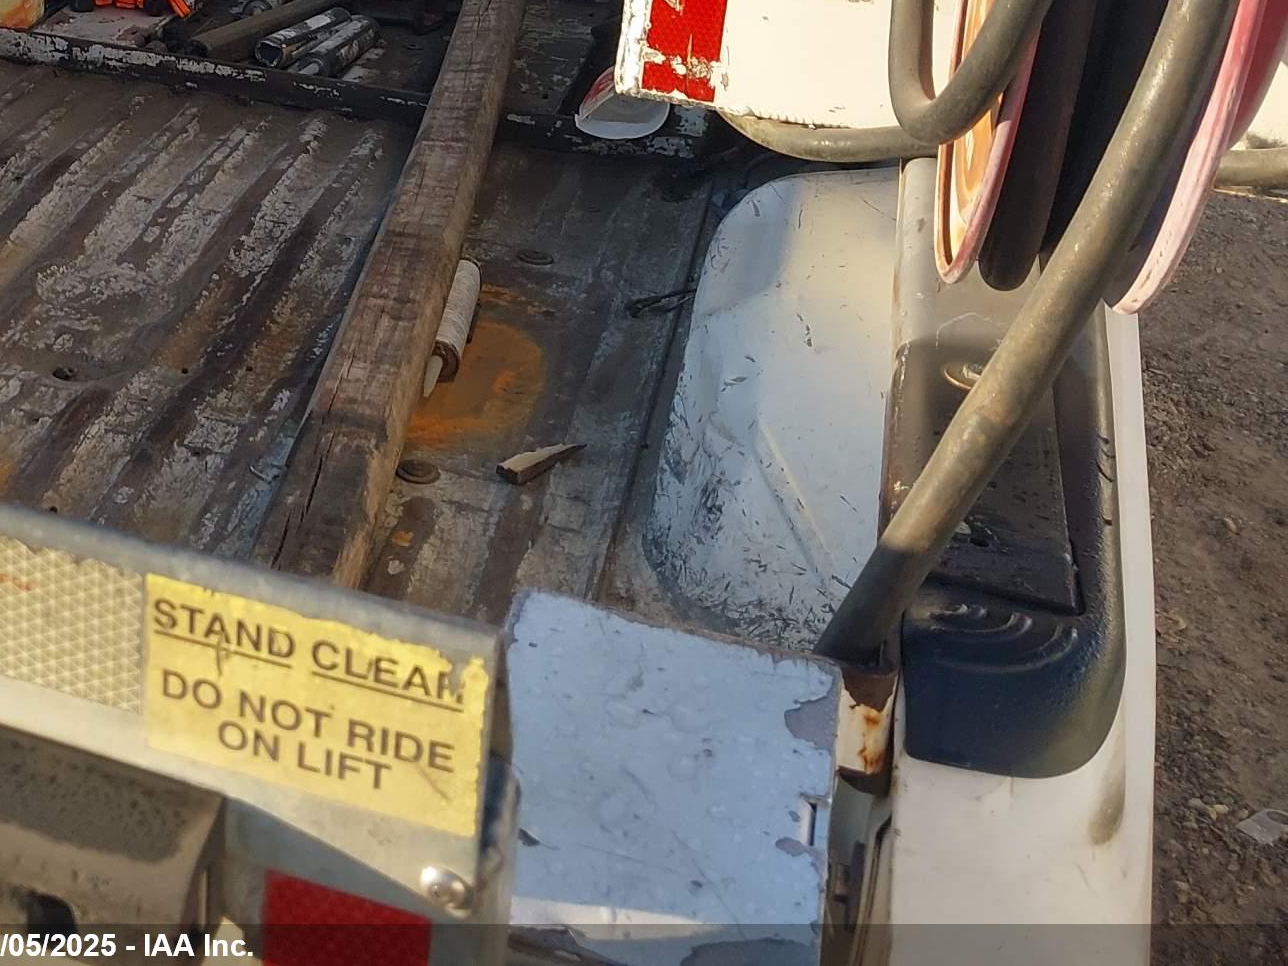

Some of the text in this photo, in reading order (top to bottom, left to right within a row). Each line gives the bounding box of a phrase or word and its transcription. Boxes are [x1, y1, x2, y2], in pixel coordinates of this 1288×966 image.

[154, 598, 295, 659] STAND
[162, 668, 455, 774] DO NOT RIDE
[218, 720, 392, 790] ON LIFT
